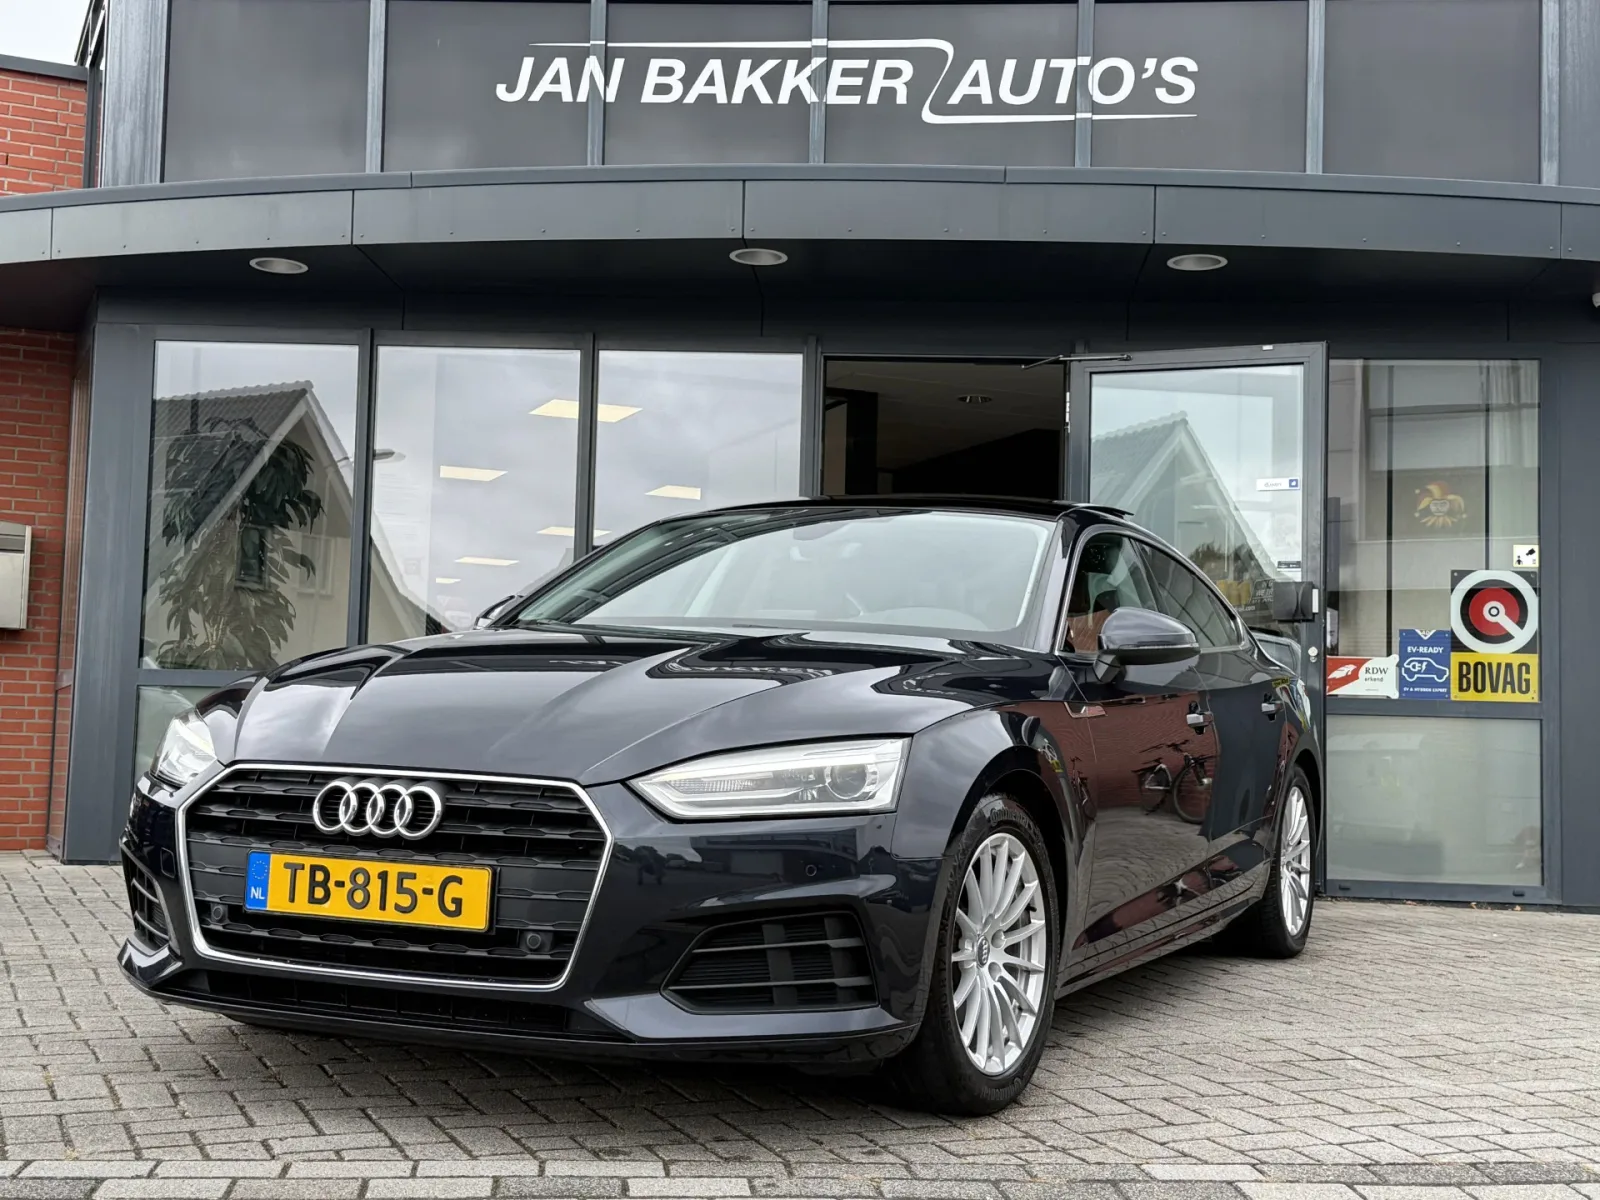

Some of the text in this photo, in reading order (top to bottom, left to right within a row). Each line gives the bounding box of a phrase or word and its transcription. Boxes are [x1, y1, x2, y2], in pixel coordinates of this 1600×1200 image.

[495, 55, 1199, 105] JAN BAKKER AUTO'S
[1407, 646, 1444, 654] EV-READY
[1364, 666, 1389, 675] RDW
[1458, 661, 1531, 695] BOVAG
[250, 886, 265, 900] NL
[283, 862, 464, 918] TB-815-G
